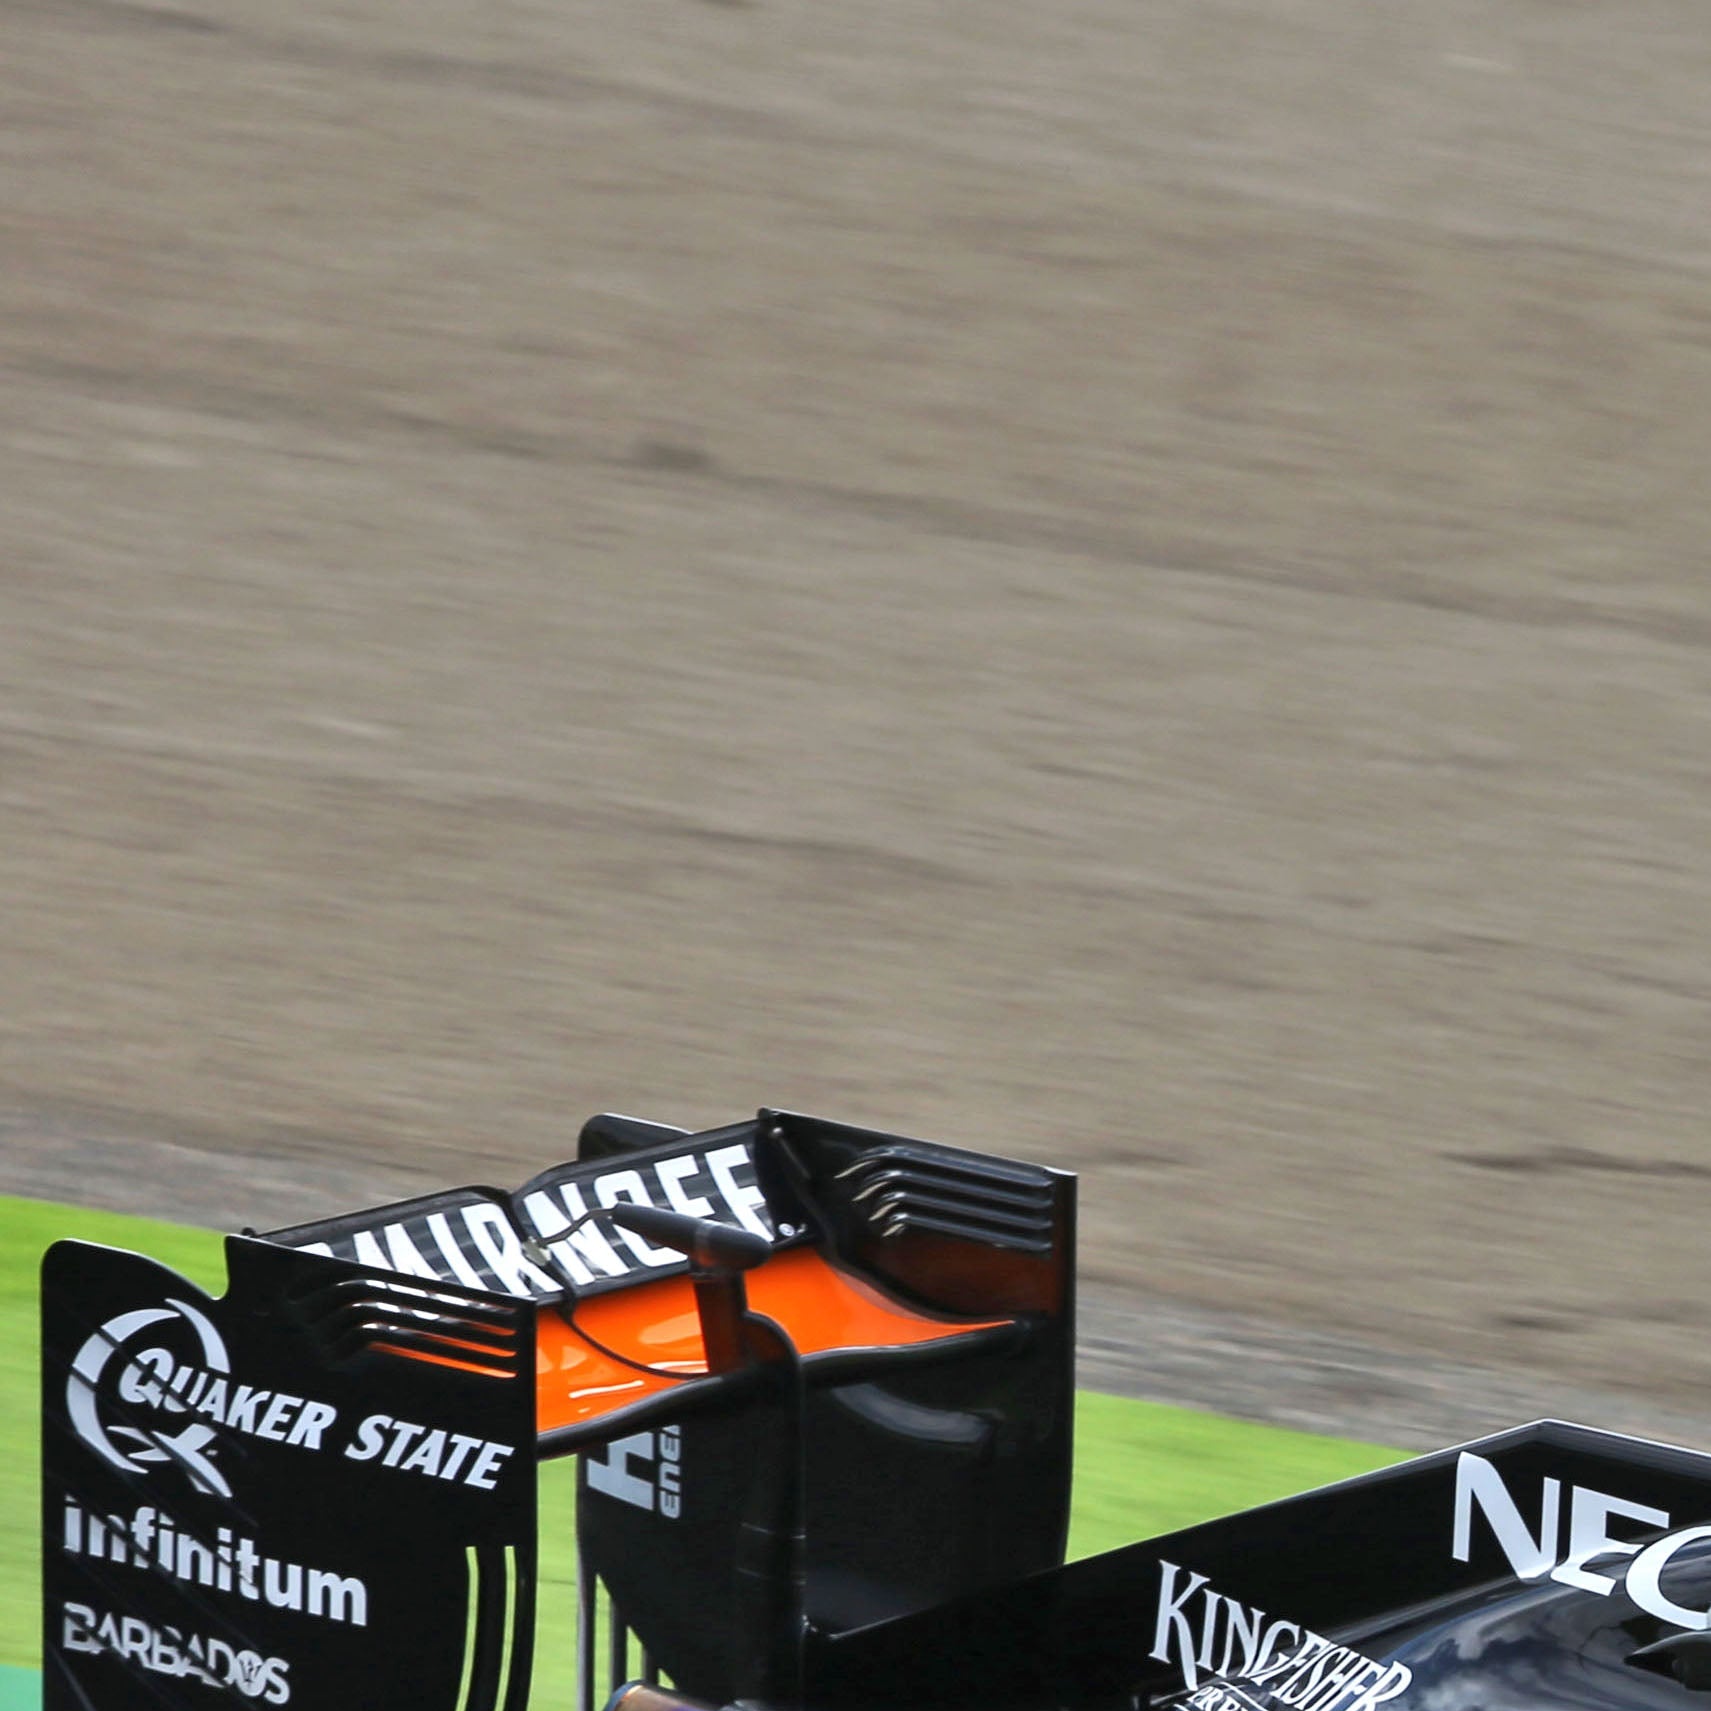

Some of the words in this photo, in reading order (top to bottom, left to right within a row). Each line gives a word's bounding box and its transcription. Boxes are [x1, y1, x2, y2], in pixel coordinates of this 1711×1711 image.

[117, 1347, 337, 1454] QUAKER
[346, 1414, 514, 1491] STATE
[64, 1496, 367, 1627] infinitum
[63, 1602, 290, 1705] BARBADOS
